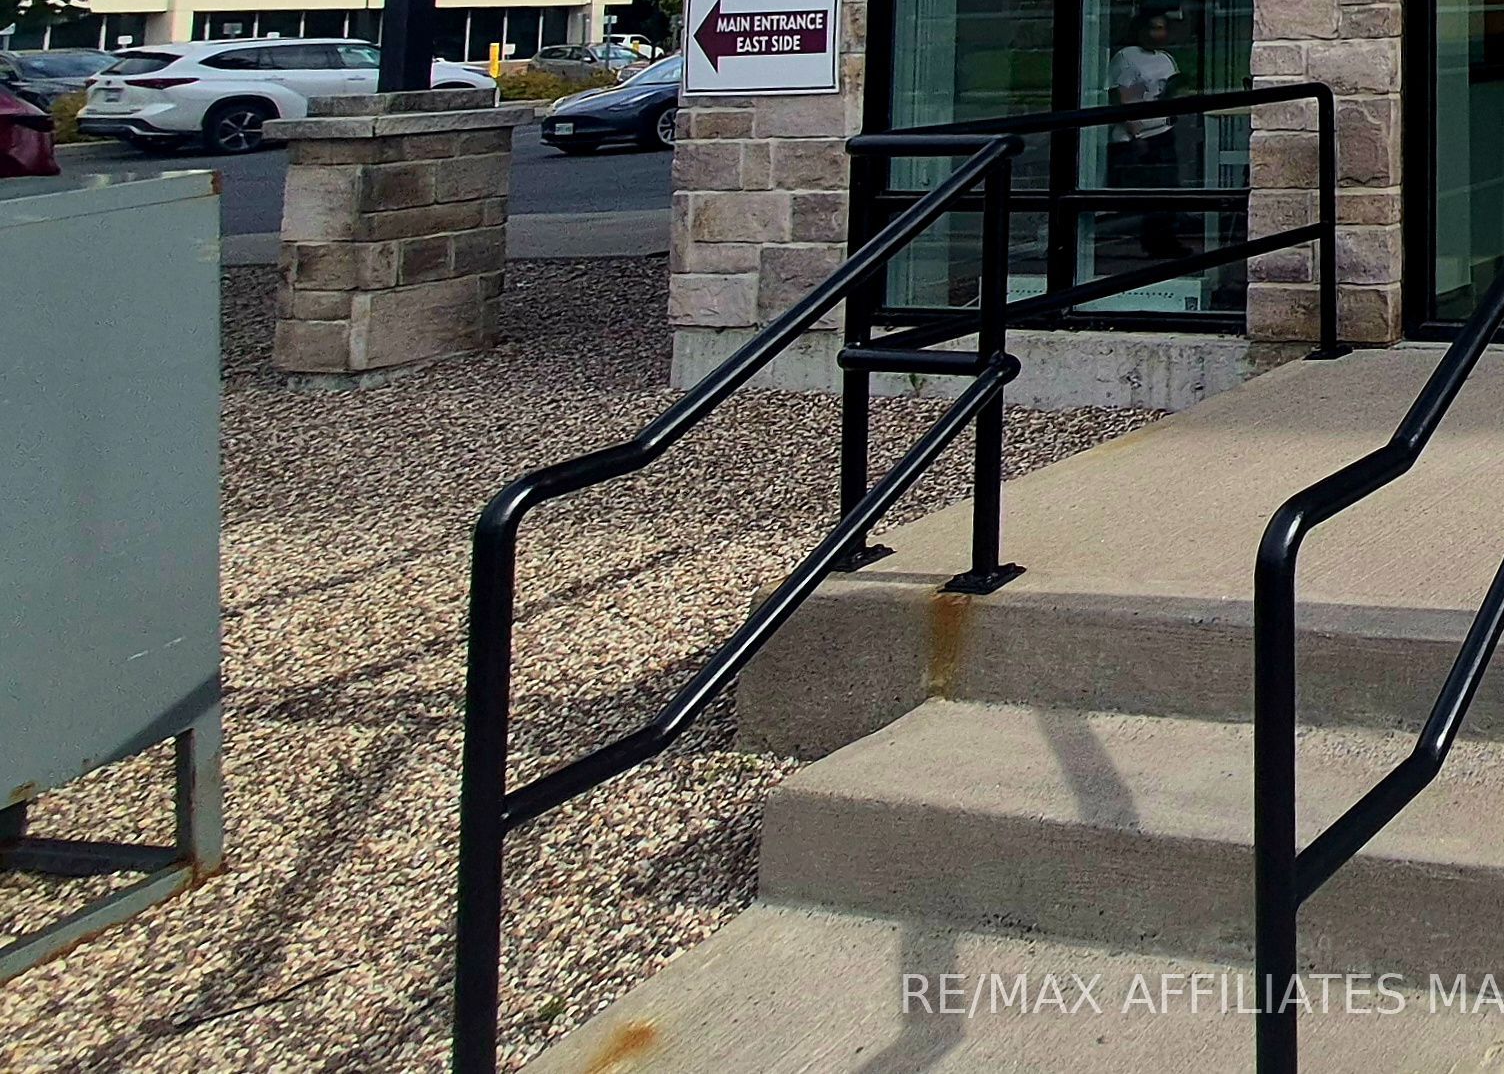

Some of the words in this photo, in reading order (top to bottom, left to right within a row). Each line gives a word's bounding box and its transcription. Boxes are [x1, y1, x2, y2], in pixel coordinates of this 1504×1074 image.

[716, 17, 750, 32] MAIN
[754, 13, 823, 31] ENTRANCE
[736, 36, 768, 52] EAST
[771, 35, 801, 51] SIDE
